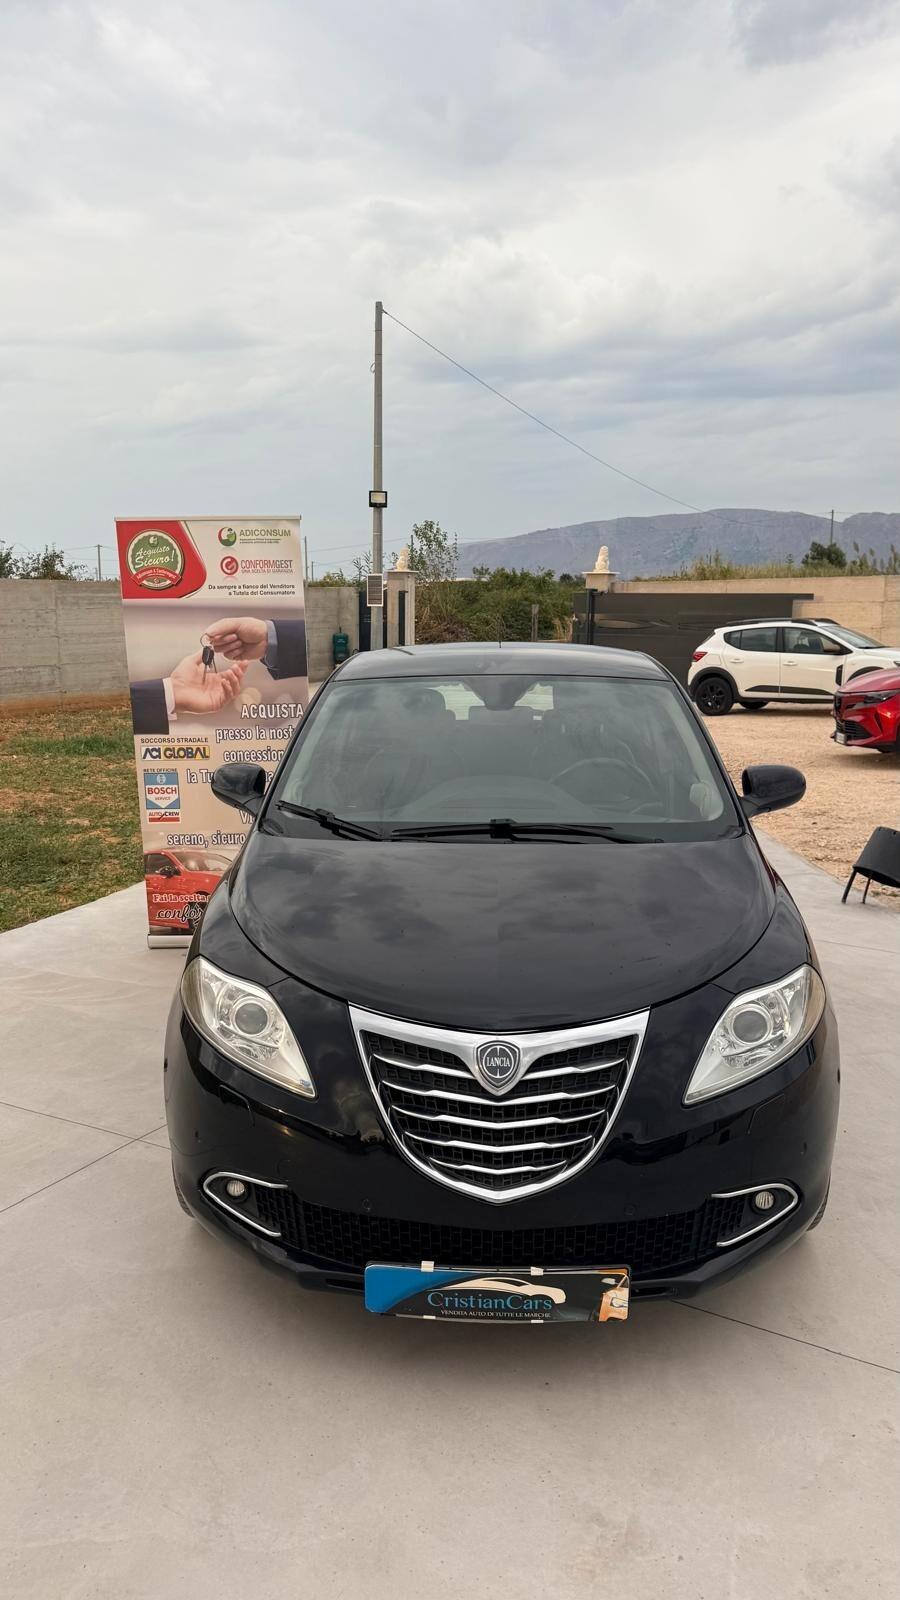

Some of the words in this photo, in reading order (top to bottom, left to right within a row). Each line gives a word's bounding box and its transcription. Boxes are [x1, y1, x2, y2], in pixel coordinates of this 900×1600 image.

[239, 529, 291, 537] ADICONSUM
[135, 545, 170, 558] Acquisto
[135, 550, 175, 568] Sicuro!
[240, 560, 293, 569] CONFORMGEST
[241, 703, 304, 719] ACQUISTA
[216, 728, 252, 743] presso
[255, 725, 266, 740] la
[270, 725, 294, 740] nost
[142, 747, 161, 759] ACI
[163, 746, 209, 759] GLOBAL
[223, 745, 284, 761] concession
[186, 768, 197, 783] la
[147, 787, 177, 795] BOSCH
[167, 832, 209, 848] sereno,
[212, 830, 246, 846] sicuro
[152, 893, 168, 903] Fai
[169, 893, 178, 903] la
[179, 893, 206, 903] scelta
[486, 1056, 511, 1067] LANCIA
[427, 1291, 553, 1310] CristianCars
